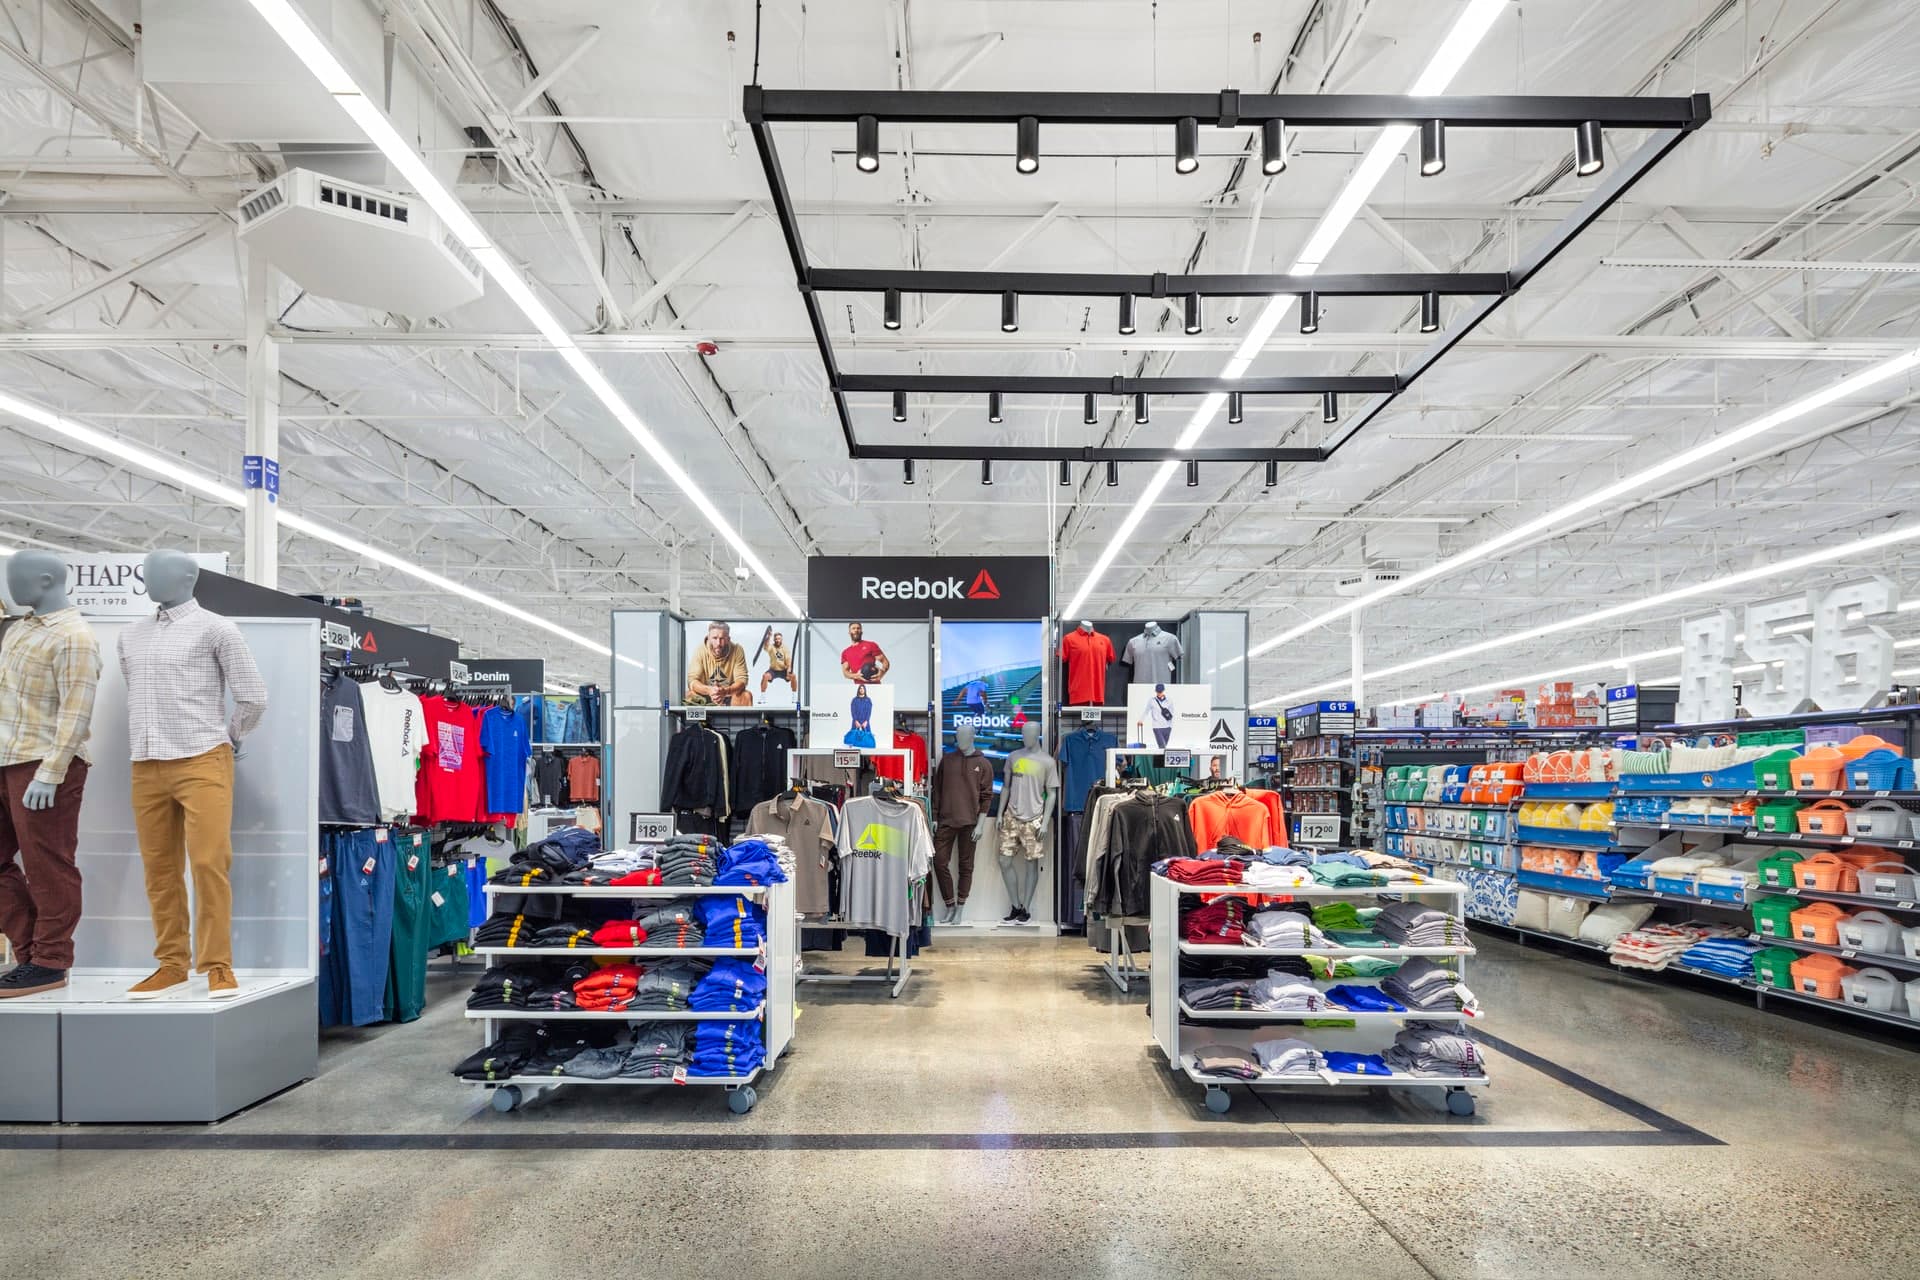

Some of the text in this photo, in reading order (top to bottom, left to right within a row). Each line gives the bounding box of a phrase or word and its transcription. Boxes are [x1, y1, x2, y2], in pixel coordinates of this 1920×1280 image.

[861, 576, 965, 599] Reebok
[76, 598, 128, 606] EST. 1978
[474, 671, 510, 681] Denim
[953, 714, 1011, 727] Reebok
[403, 709, 413, 747] Reebok
[852, 849, 882, 859] Reebok
